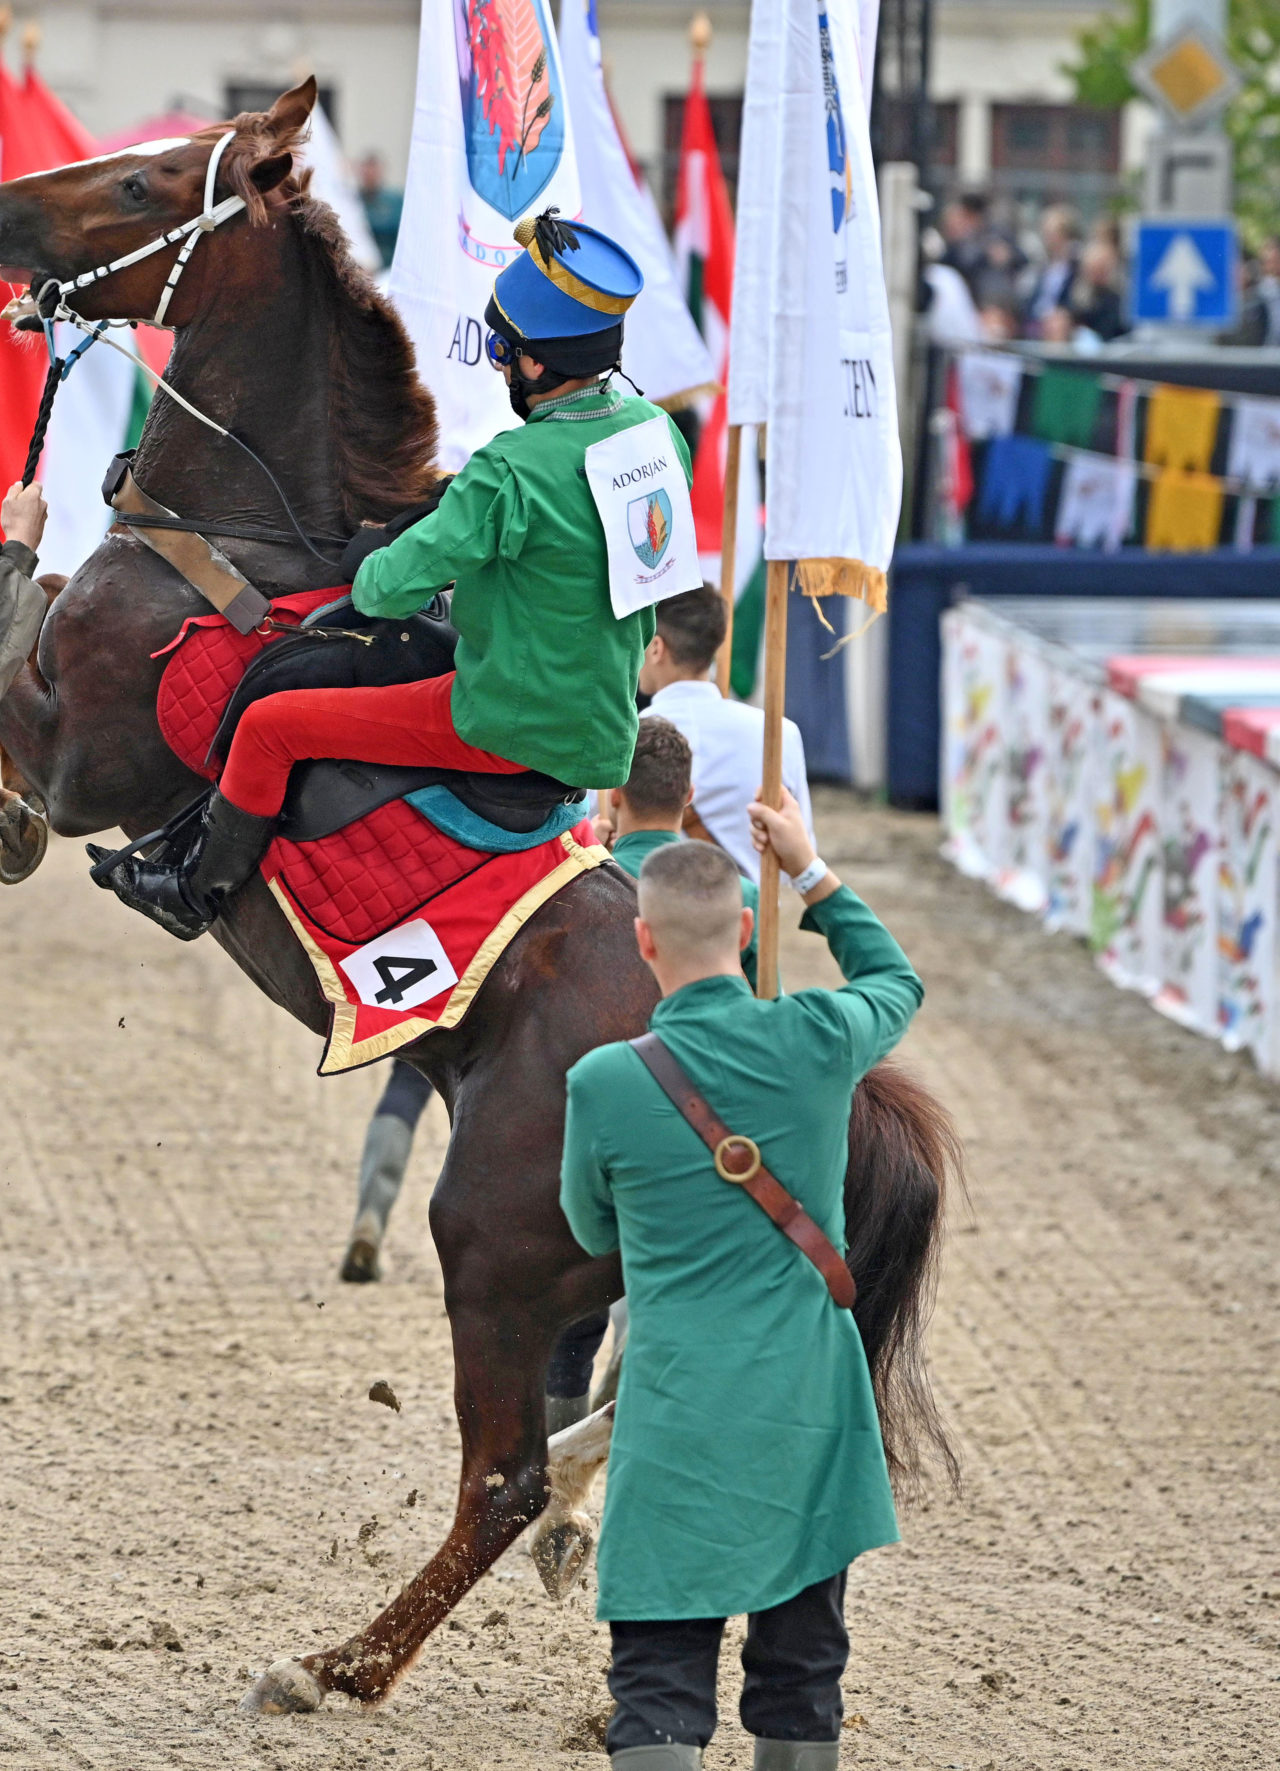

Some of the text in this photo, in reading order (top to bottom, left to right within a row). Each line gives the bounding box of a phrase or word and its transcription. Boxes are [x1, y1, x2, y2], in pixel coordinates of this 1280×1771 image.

[462, 235, 522, 266] ADO
[612, 456, 668, 491] ADORJÁN
[373, 956, 437, 1004] 4
